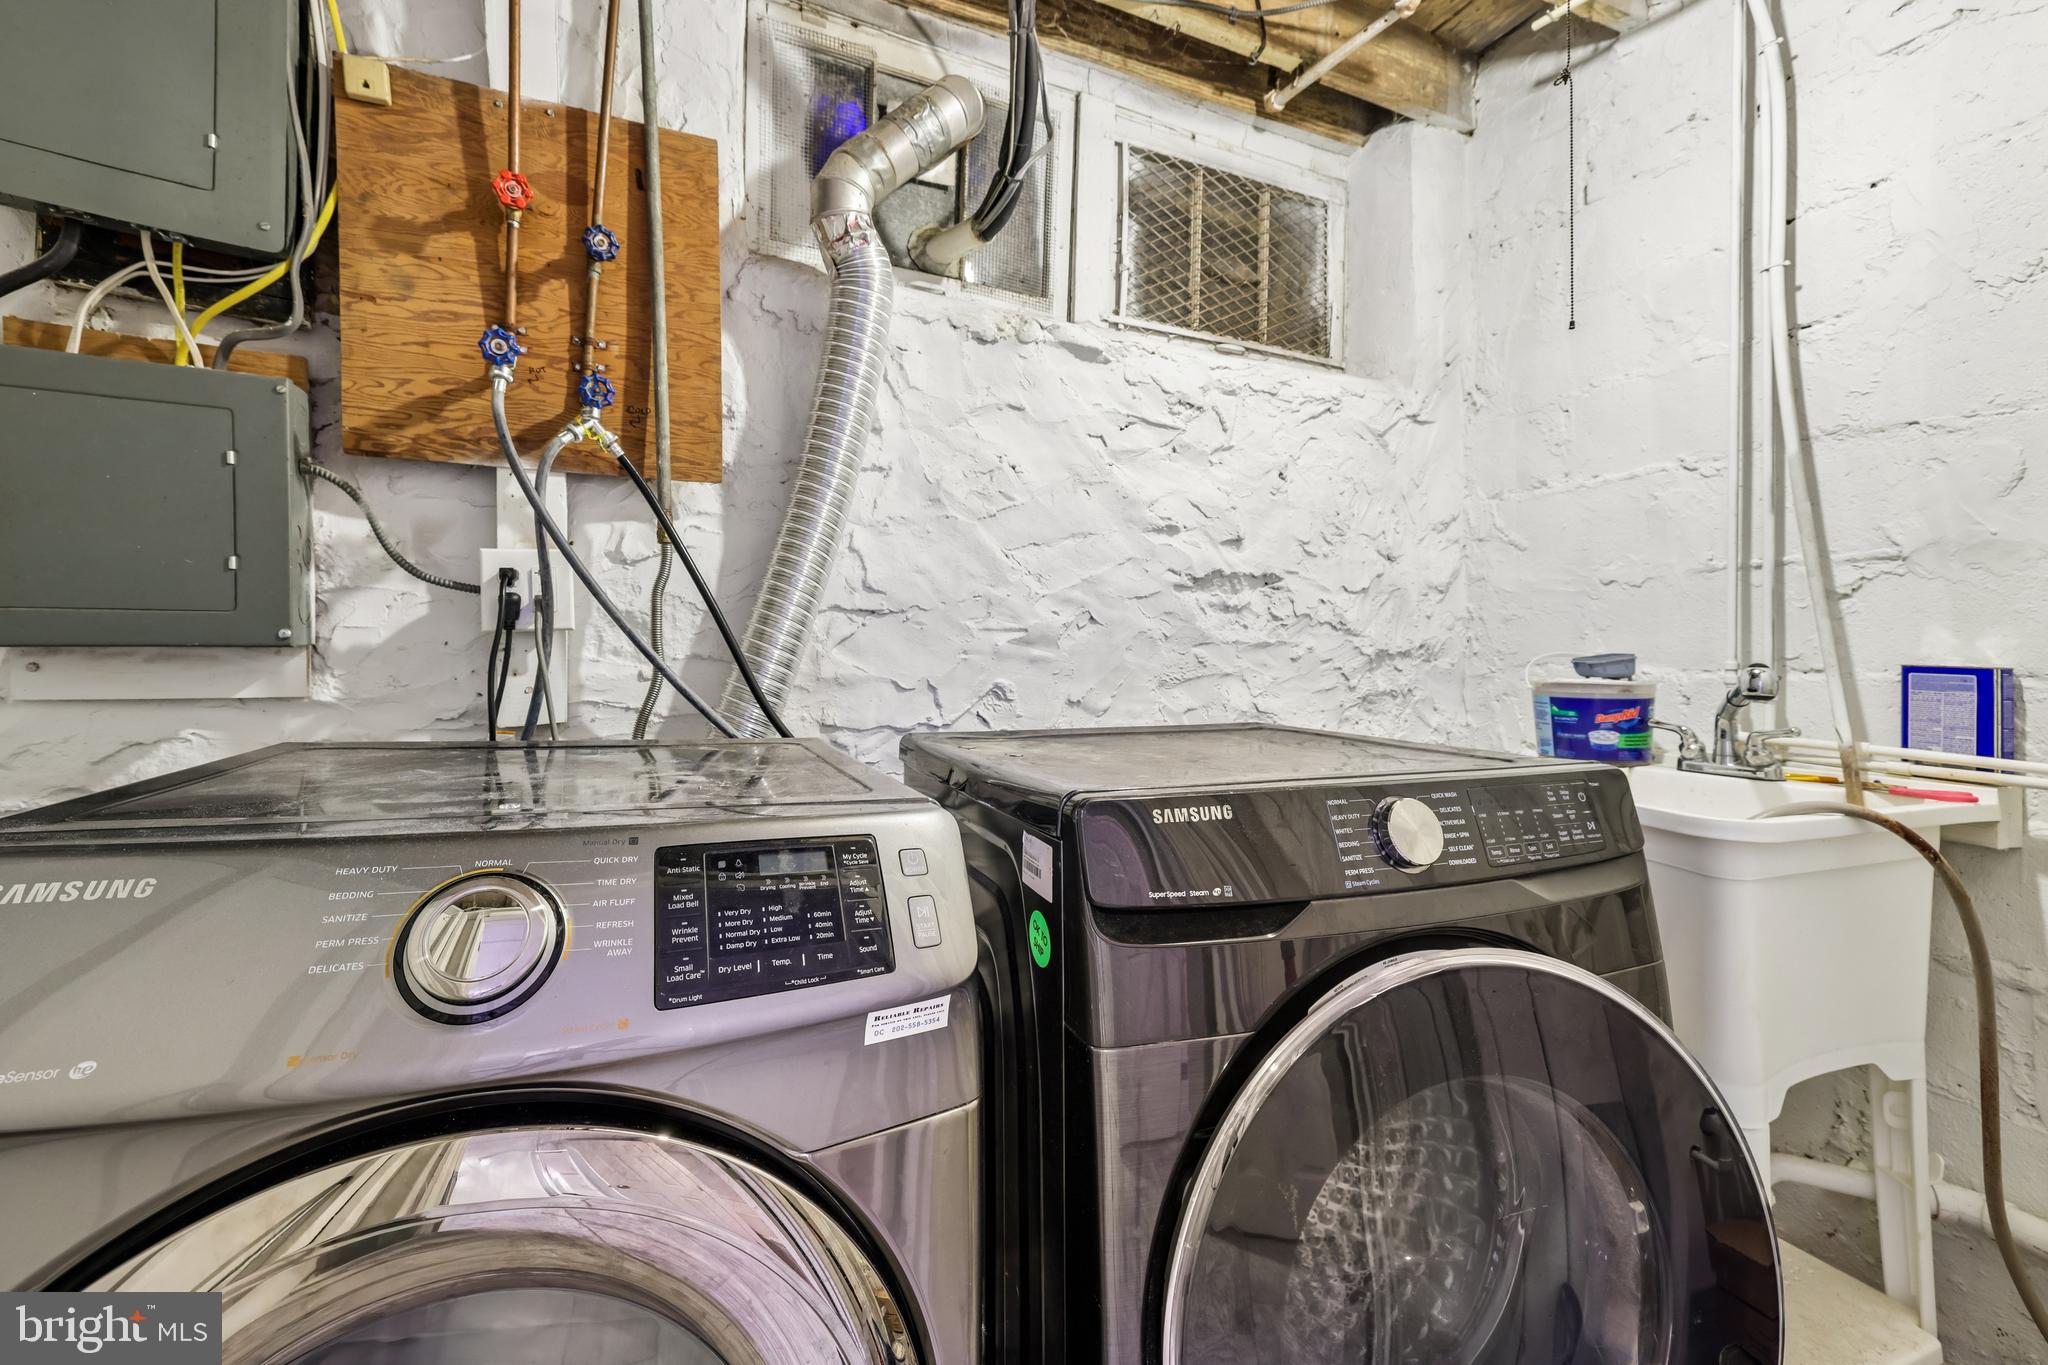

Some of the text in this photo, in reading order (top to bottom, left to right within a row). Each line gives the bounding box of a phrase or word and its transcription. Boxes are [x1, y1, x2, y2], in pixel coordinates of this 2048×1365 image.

[1327, 798, 1348, 806] NORMAL
[1152, 804, 1233, 824] SAMSUNG
[1335, 827, 1354, 835] WHITES
[582, 838, 626, 847] Manual Dry
[1338, 840, 1361, 848] BEDDING
[593, 855, 639, 865] QUICK DRY
[842, 852, 868, 861] My Cycle
[1341, 854, 1364, 862] SANITIZE
[474, 859, 514, 868] NORMAL
[1448, 857, 1477, 866] DOWNLOADED
[335, 865, 399, 876] HEAVY DUTY
[682, 865, 701, 873] Static
[1344, 867, 1375, 876] PERM PRESS
[596, 878, 617, 886] TIME
[849, 878, 868, 887] Adjust
[1351, 879, 1366, 887] Steam
[759, 884, 777, 892] Drying
[779, 882, 797, 890] Cooling
[328, 890, 375, 901] BEDDING
[672, 893, 694, 901] Mixed
[1189, 888, 1210, 897] Steam
[592, 898, 636, 907] AIR FLUFF
[668, 900, 699, 909] Load Bell
[768, 904, 783, 912] High
[854, 908, 873, 917] Adjust
[321, 913, 369, 924] SANITIZE
[769, 914, 794, 922] Medium
[813, 910, 832, 918] 60min
[595, 920, 635, 929] REFRESH
[724, 918, 754, 928] More Dry
[855, 916, 870, 924] Time
[915, 921, 935, 929] START
[671, 926, 699, 936] Wrinkle
[725, 929, 761, 939] Normal Dry
[315, 936, 380, 949] PERM PRESS
[593, 938, 633, 948] WRINKLE
[671, 935, 699, 944] Prevent
[771, 936, 787, 944] Extra
[726, 940, 758, 951] Damp Dry
[859, 944, 878, 953] Sound
[606, 948, 633, 957] AWAY
[816, 952, 834, 961] Time
[771, 958, 792, 967] Temp.
[308, 961, 365, 974] DELICATES
[674, 963, 694, 973] Small
[718, 962, 753, 975] Dry Level
[874, 965, 885, 973] Care
[666, 974, 684, 982] Load
[807, 976, 820, 984] Lock
[688, 994, 703, 1002] Light
[873, 1028, 885, 1037] DC
